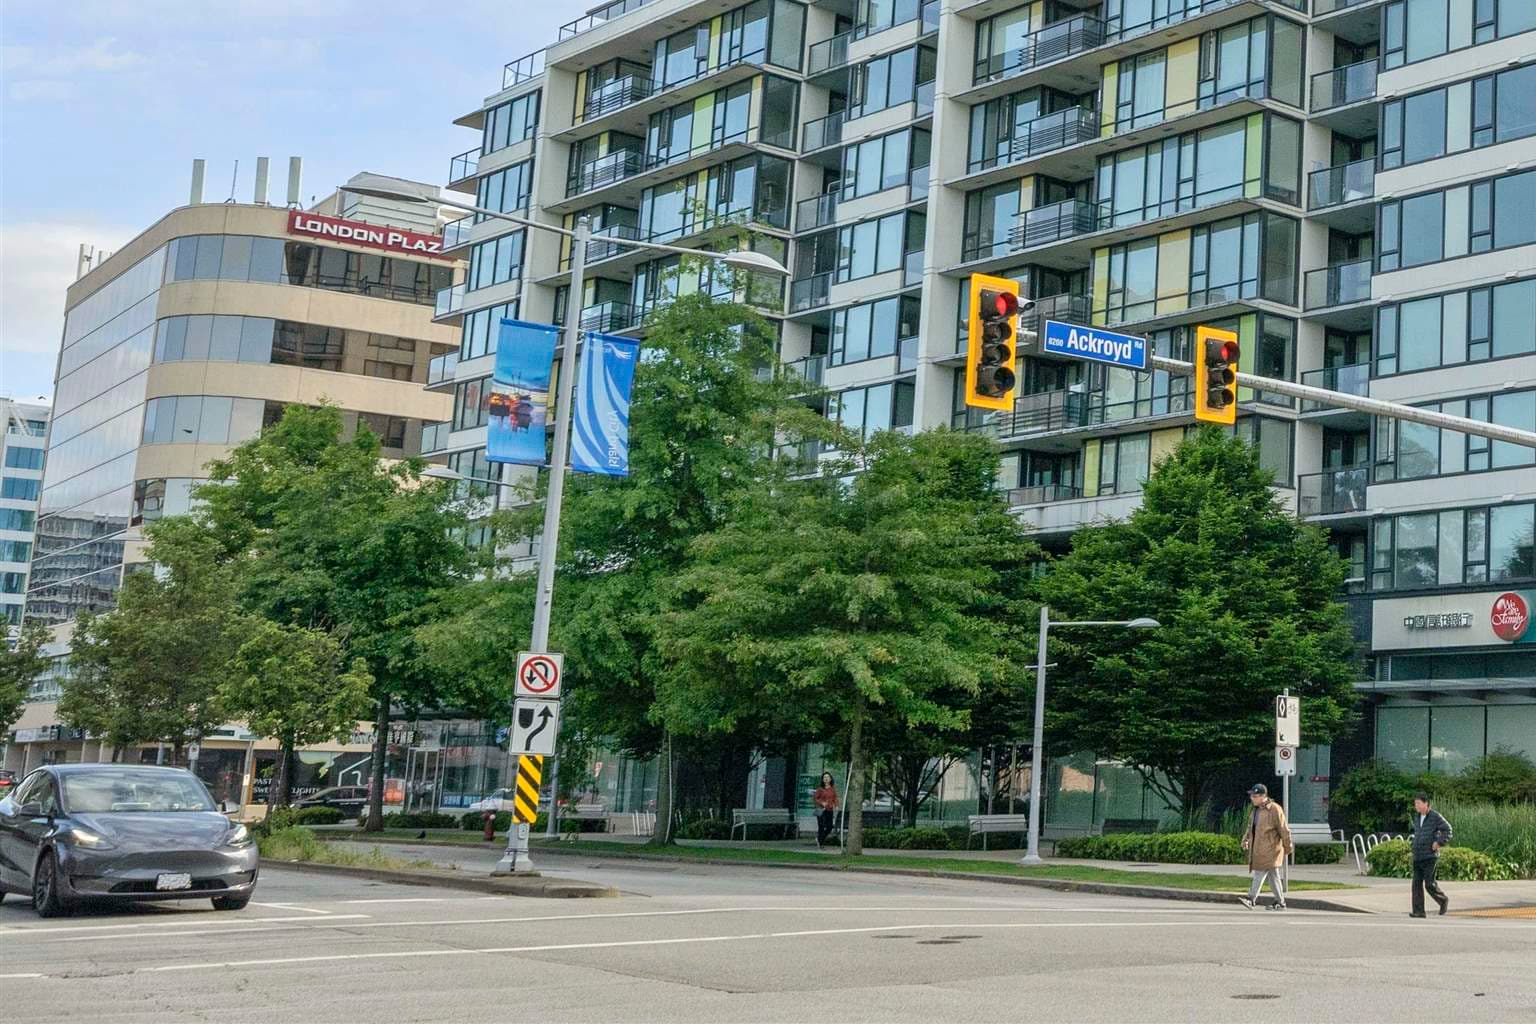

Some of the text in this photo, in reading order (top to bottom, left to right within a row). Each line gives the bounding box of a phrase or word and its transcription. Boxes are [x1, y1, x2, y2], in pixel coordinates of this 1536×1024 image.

[294, 216, 441, 254] LONDON PLAZ
[1067, 328, 1132, 361] Ackroyd
[1134, 340, 1143, 349] Rd
